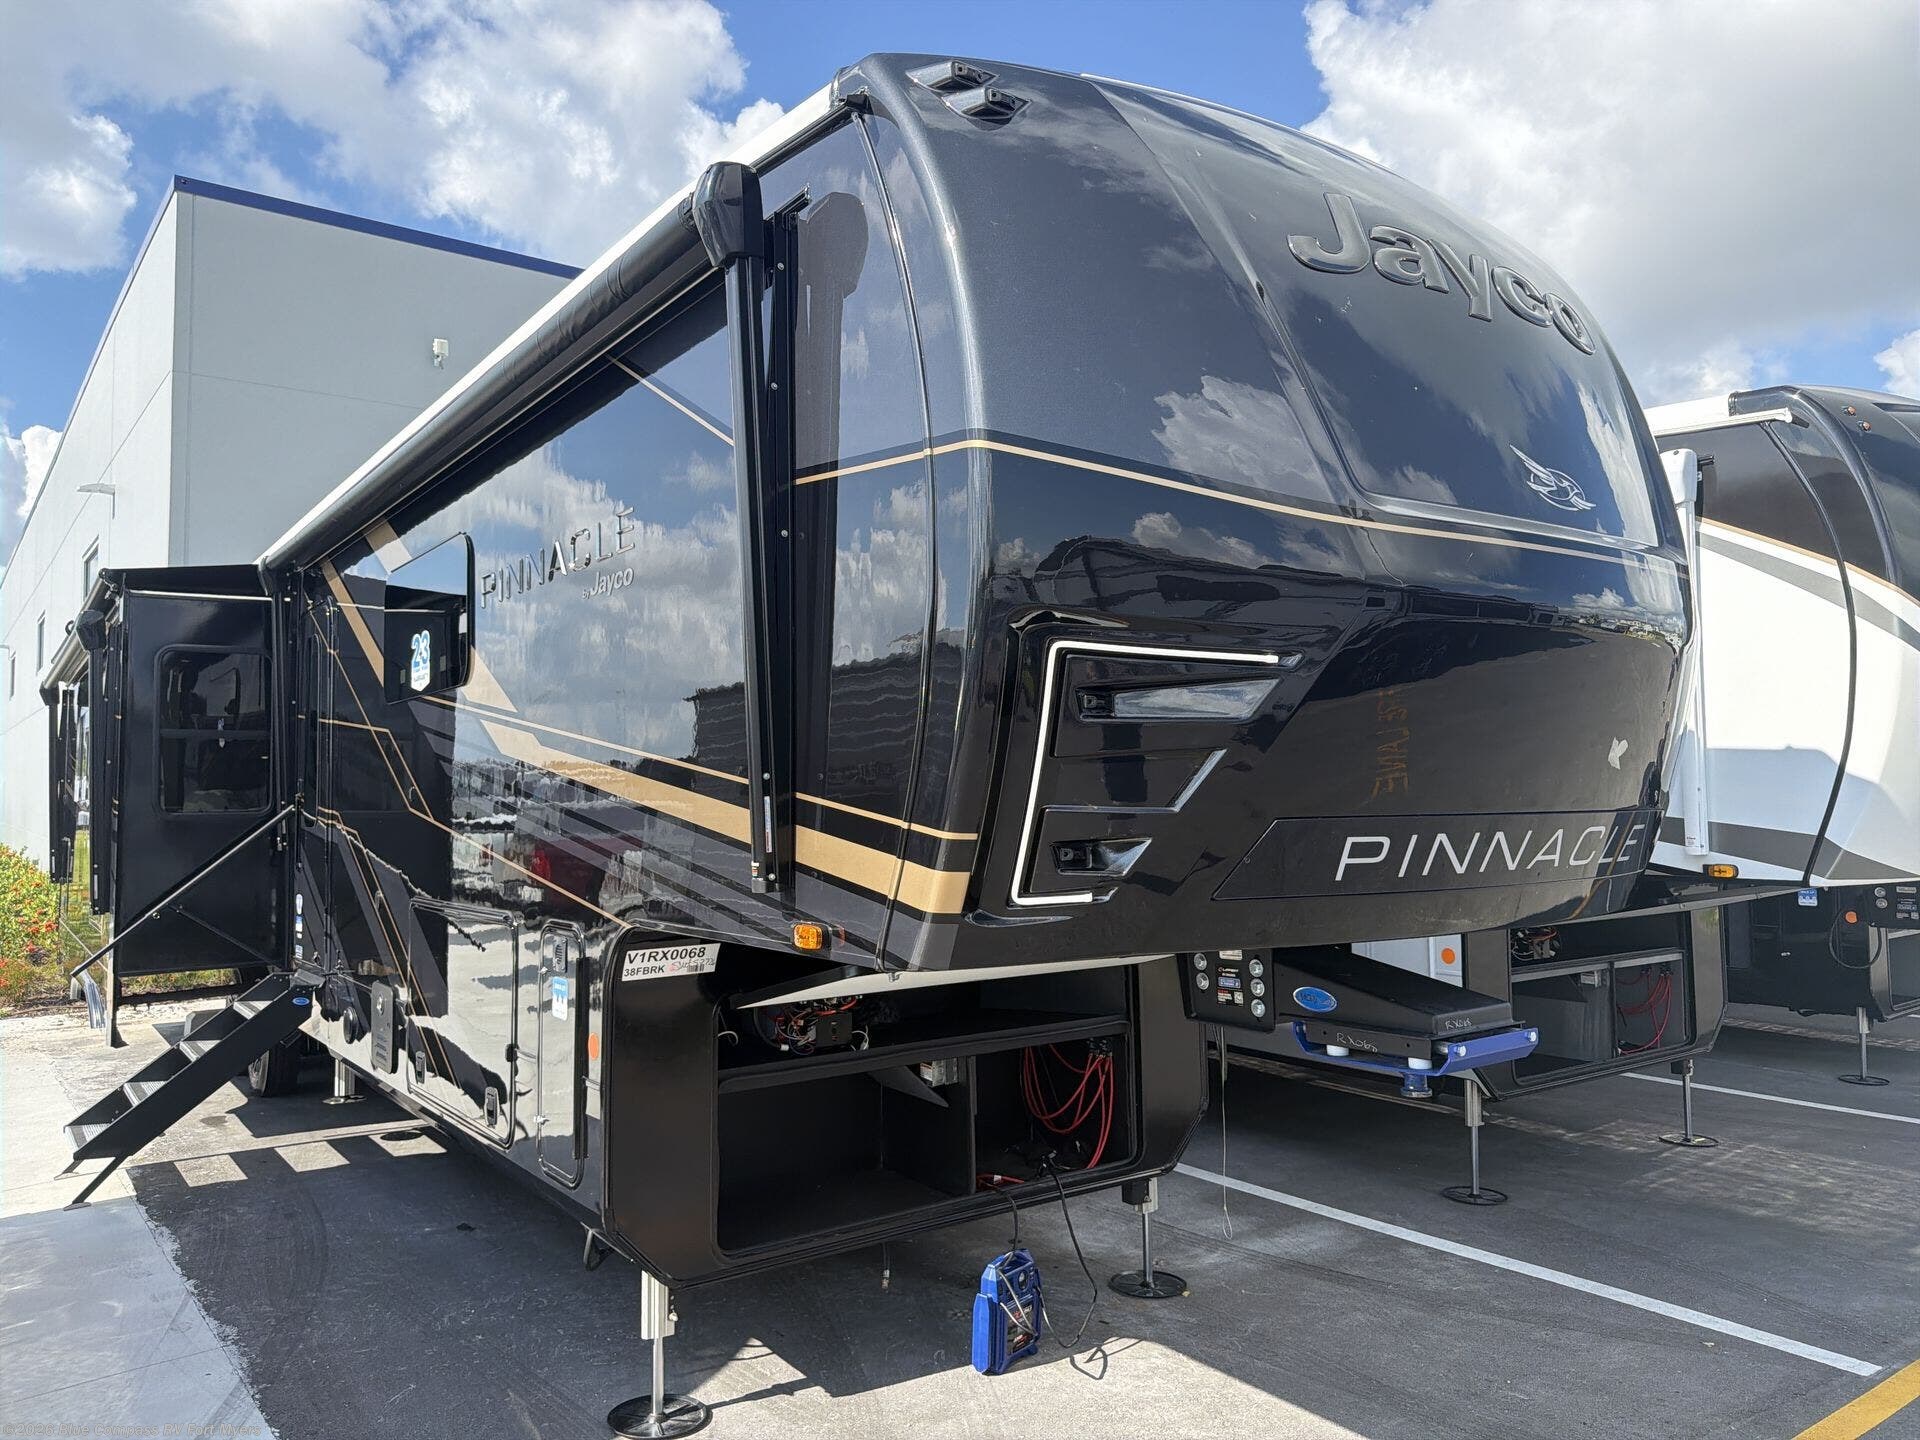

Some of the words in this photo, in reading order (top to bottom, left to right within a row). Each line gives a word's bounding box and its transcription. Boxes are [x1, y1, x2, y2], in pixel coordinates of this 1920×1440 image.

[1287, 191, 1595, 355] Jayco
[480, 506, 635, 609] PINNACLE
[590, 567, 634, 597] Jayco
[1334, 824, 1645, 881] PINNACLE
[624, 964, 665, 977] 38FBRK
[627, 946, 706, 964] V1RX0068
